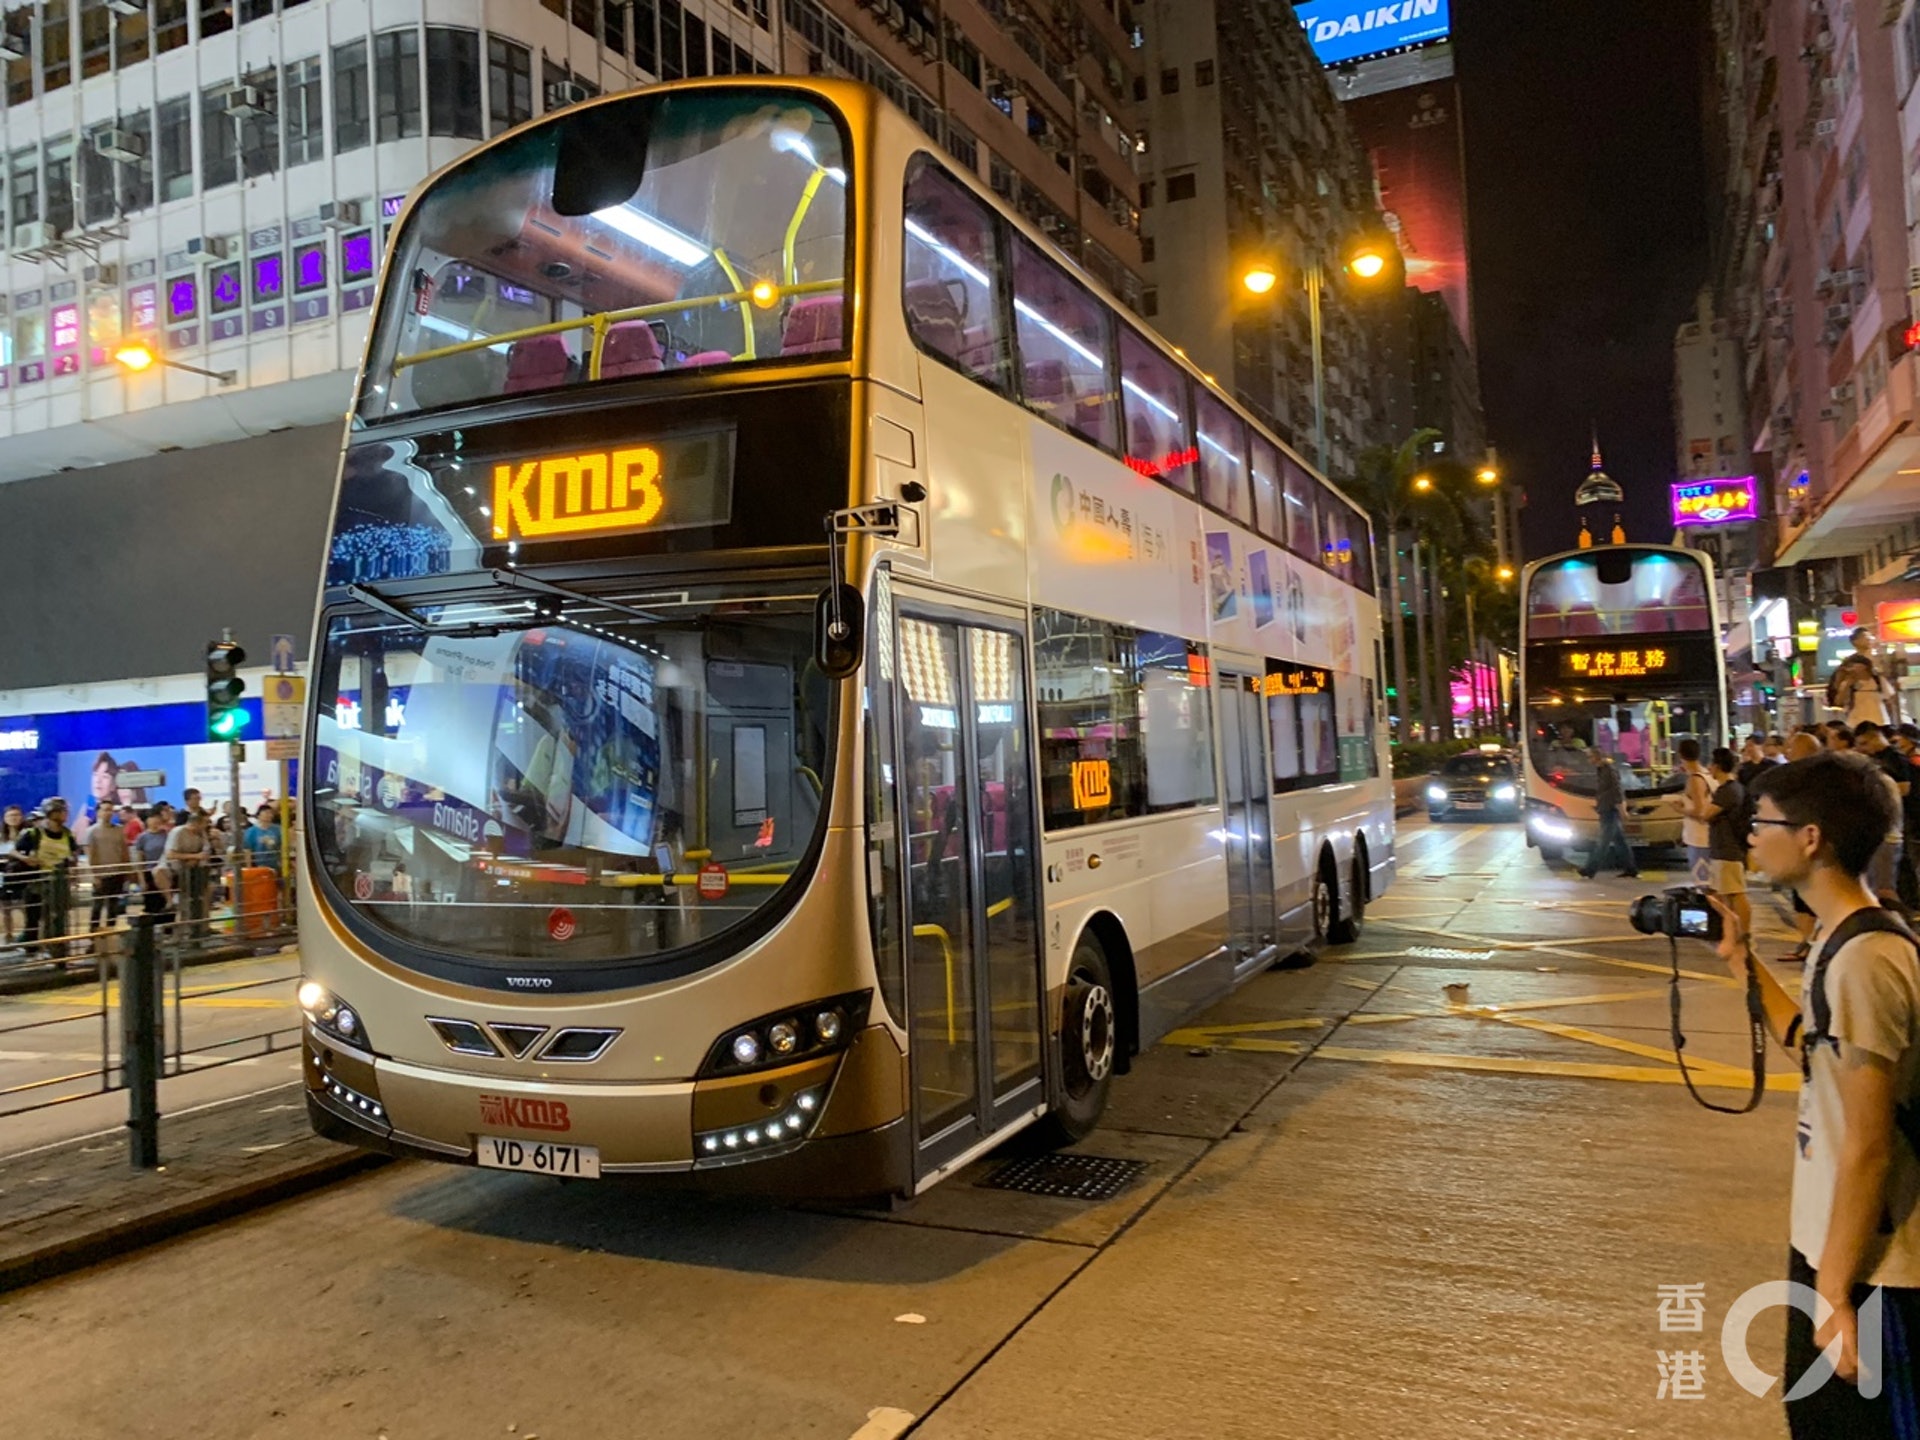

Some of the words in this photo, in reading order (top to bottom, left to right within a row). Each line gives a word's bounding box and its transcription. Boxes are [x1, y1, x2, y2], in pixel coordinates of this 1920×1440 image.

[1314, 0, 1439, 43] DAIKIN
[265, 310, 277, 327] 9
[355, 289, 365, 306] 1
[493, 448, 663, 540] KMB
[1571, 649, 1666, 671] 暫停服務
[1072, 760, 1112, 810] KMB
[506, 977, 552, 988] VOLVO
[493, 1140, 523, 1166] VD
[533, 1145, 579, 1174] 6171
